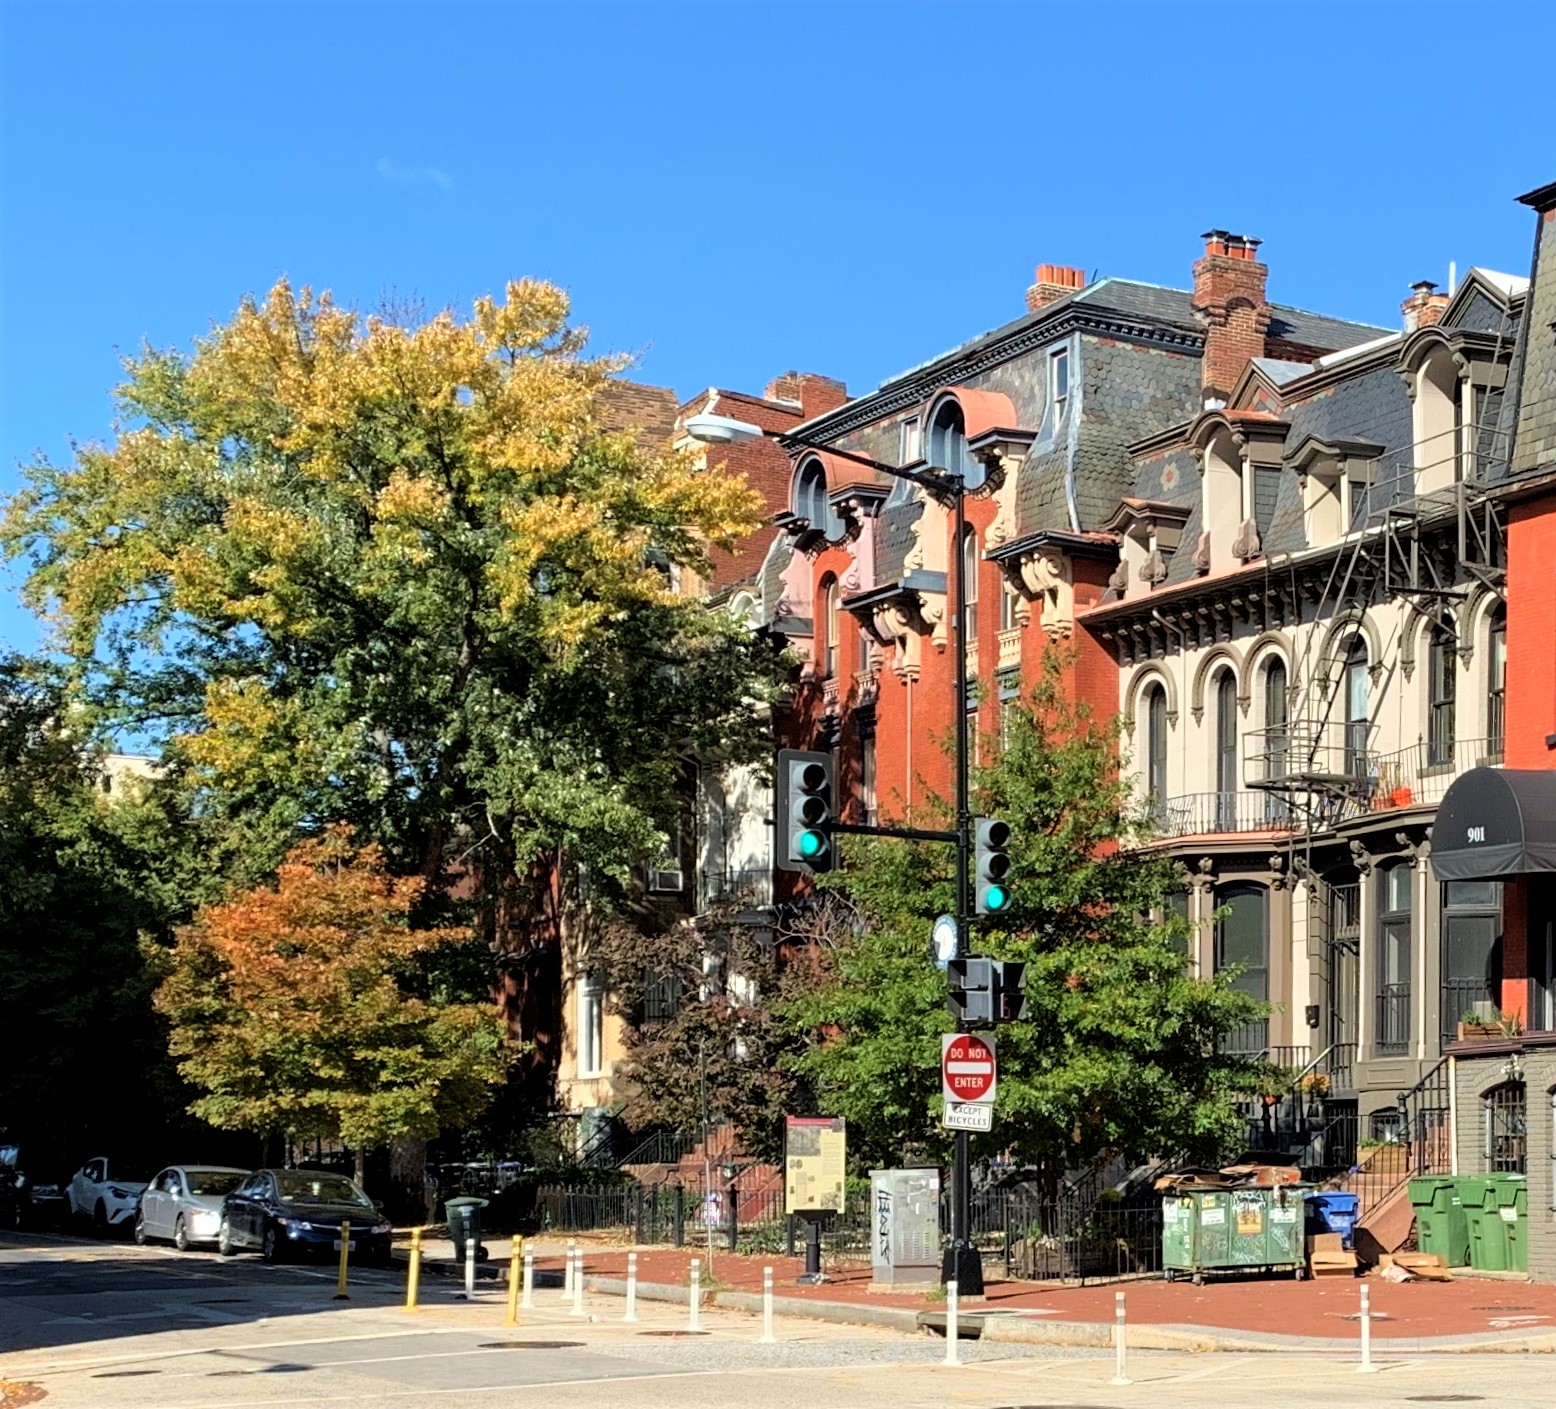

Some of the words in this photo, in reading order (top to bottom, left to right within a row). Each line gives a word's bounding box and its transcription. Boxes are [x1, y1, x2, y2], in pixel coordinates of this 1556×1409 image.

[1467, 827, 1485, 843] 901
[951, 1048, 963, 1058] DO
[968, 1048, 986, 1058] NOT
[954, 1077, 983, 1088] ENTER
[948, 1116, 987, 1126] BICYCLES
